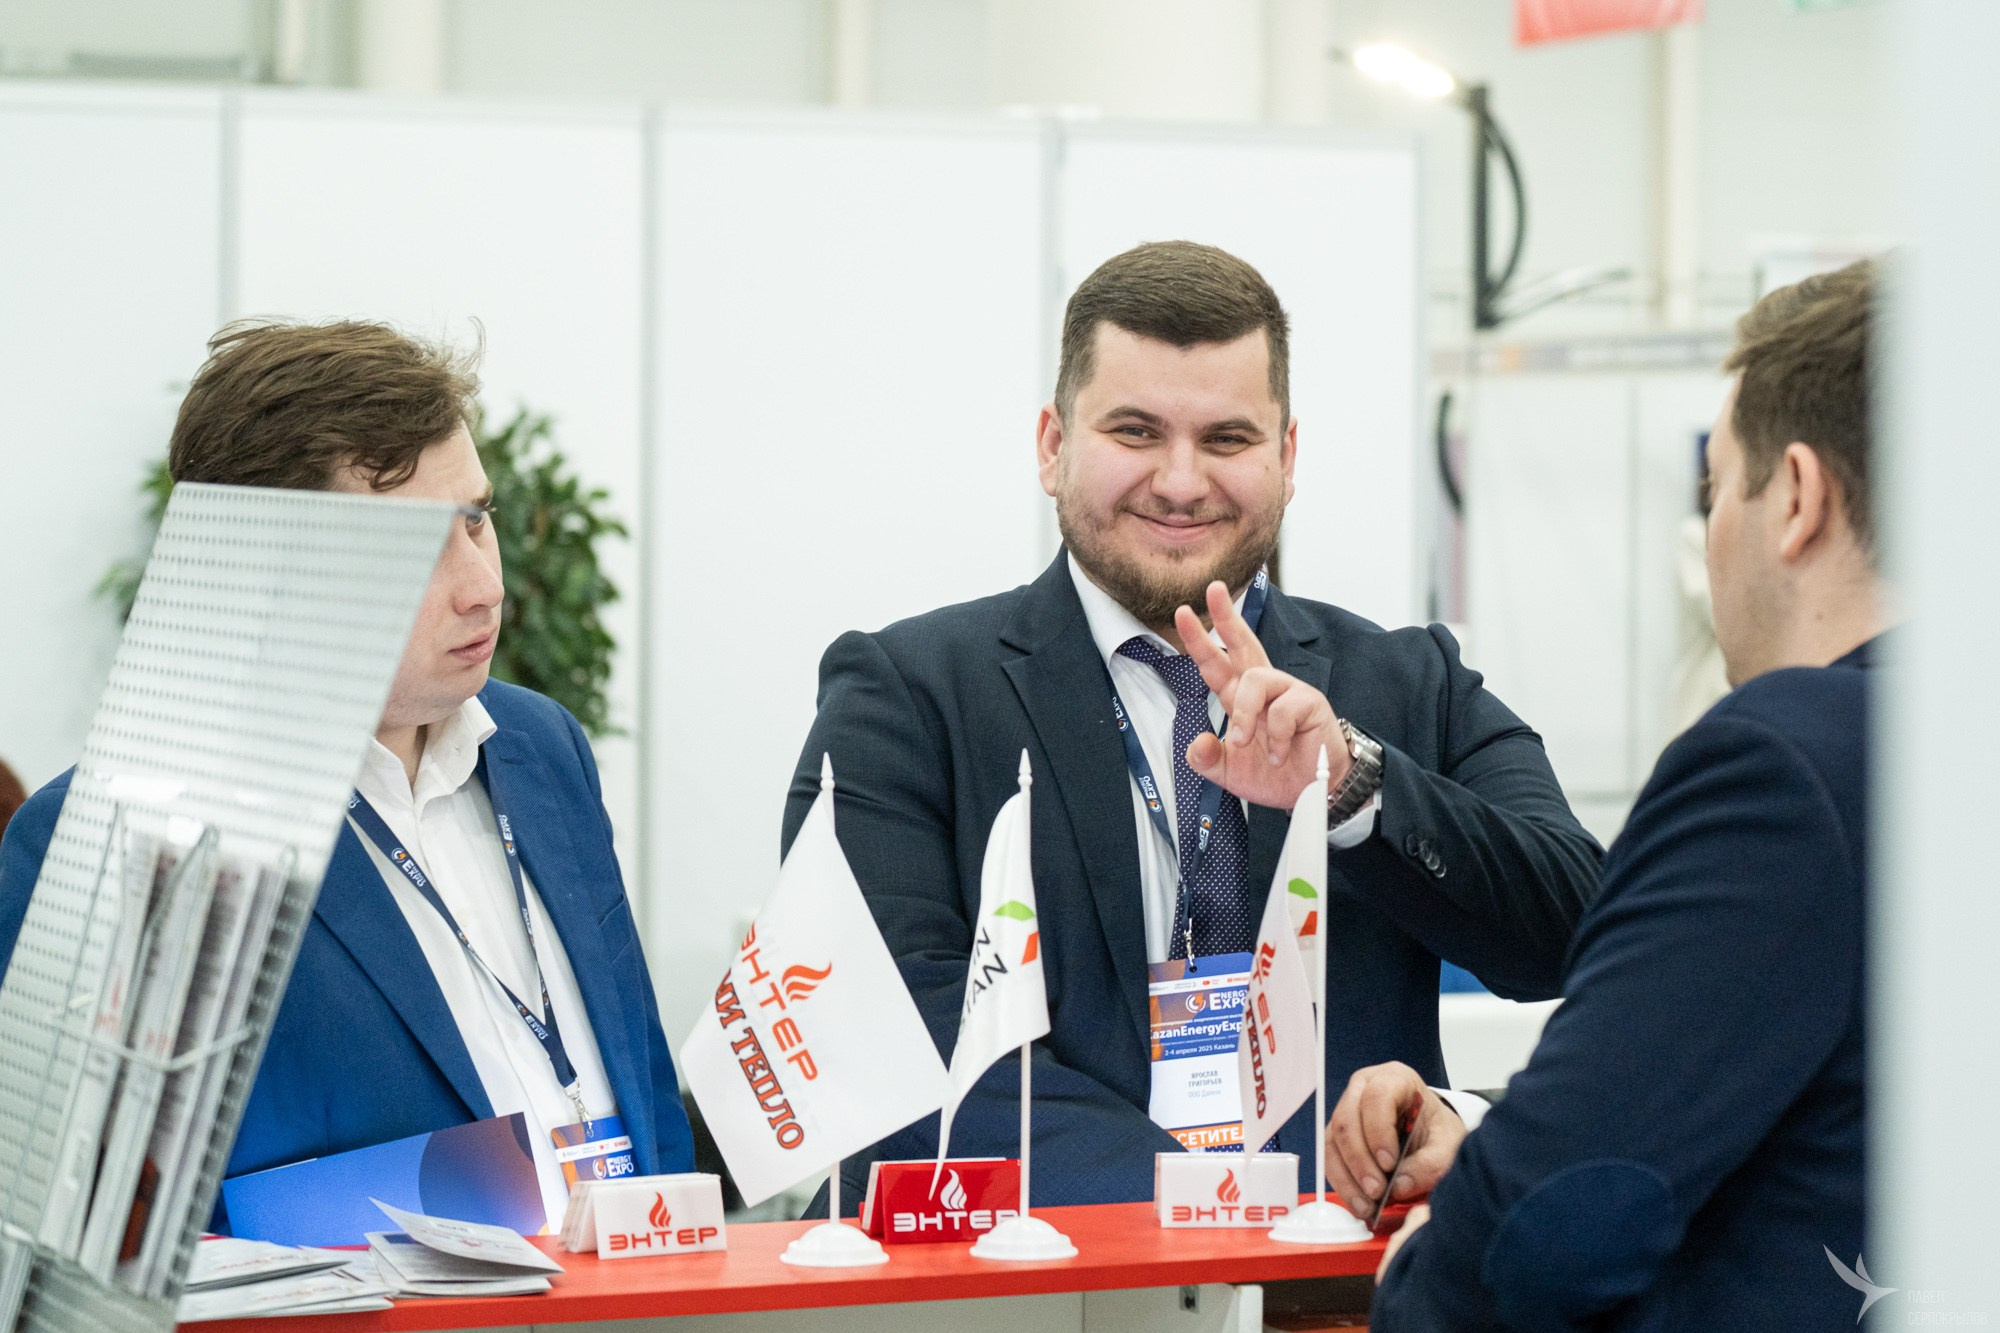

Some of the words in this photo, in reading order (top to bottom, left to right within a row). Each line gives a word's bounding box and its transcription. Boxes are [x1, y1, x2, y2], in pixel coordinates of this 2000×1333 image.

[402, 859, 425, 887] EXPO
[1151, 1021, 1243, 1039] azanEnergyExp
[1175, 1047, 1197, 1055] апреля
[1214, 1043, 1236, 1051] Казань
[1188, 1078, 1222, 1087] ГРИГОРЬЕВ
[1191, 1070, 1218, 1079] ЯРОСЛАВ
[731, 1026, 804, 1150] ТЕПЛО
[606, 1157, 634, 1177] EXPO
[1172, 1206, 1289, 1222] ЭНТЕР
[609, 1227, 718, 1251] ЭНТЕР
